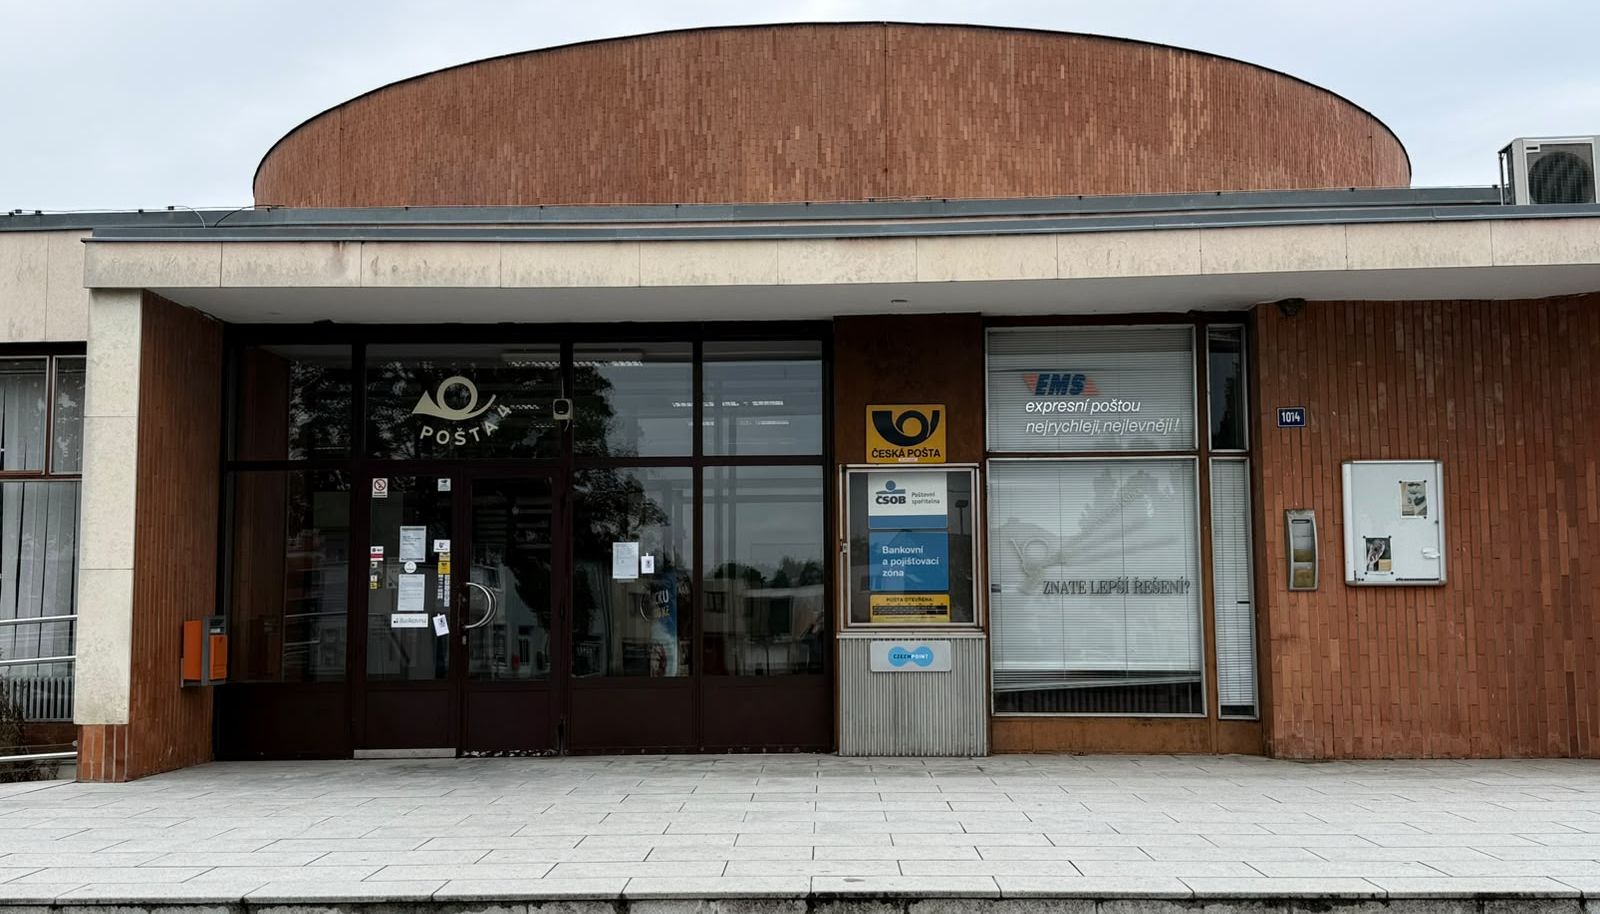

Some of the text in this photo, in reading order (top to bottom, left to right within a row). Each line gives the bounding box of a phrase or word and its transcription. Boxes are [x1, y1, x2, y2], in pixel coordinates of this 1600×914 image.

[1035, 373, 1087, 396] EMS
[1025, 398, 1141, 415] expresní poštou
[1281, 411, 1301, 423] 1014
[420, 404, 512, 446] POŠTA 4
[1025, 419, 1101, 436] nejrychleji,
[871, 446, 941, 458] ČESKÁ POŠTA
[875, 494, 906, 505] ČSOB
[882, 545, 924, 554] Bankovní
[882, 558, 888, 566] a
[882, 569, 905, 577] zóna
[1090, 576, 1129, 595] LEPŠÍ
[1133, 576, 1191, 595] ŘEŠENÍ?
